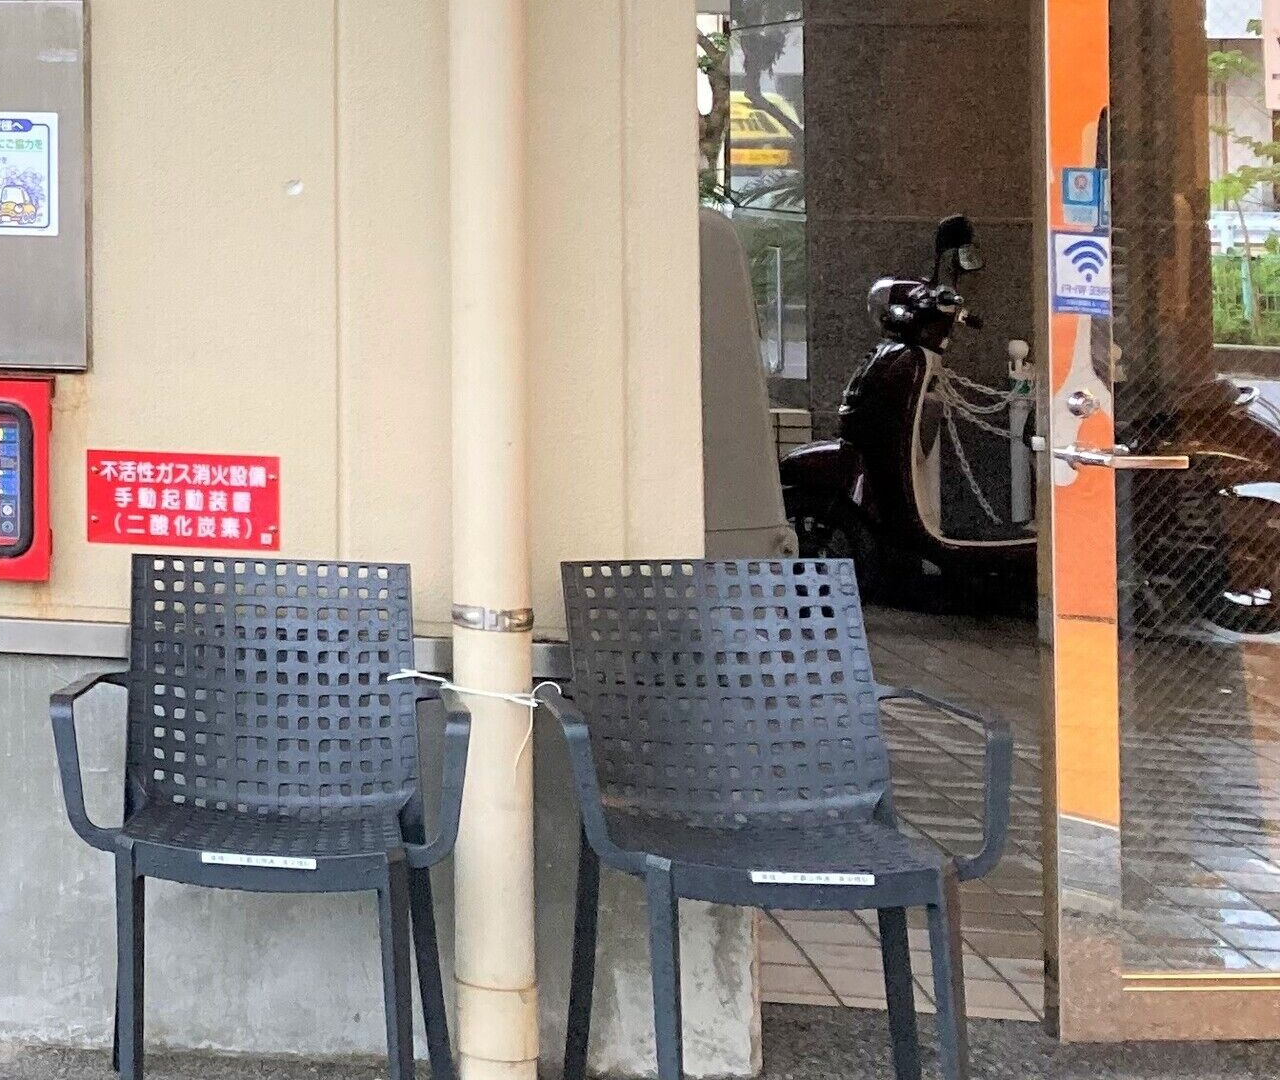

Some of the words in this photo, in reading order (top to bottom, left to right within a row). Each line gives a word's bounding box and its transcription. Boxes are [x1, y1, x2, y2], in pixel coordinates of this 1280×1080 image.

[99, 461, 267, 488] 不活性ガス消火設備
[114, 487, 252, 513] 手動起動装置
